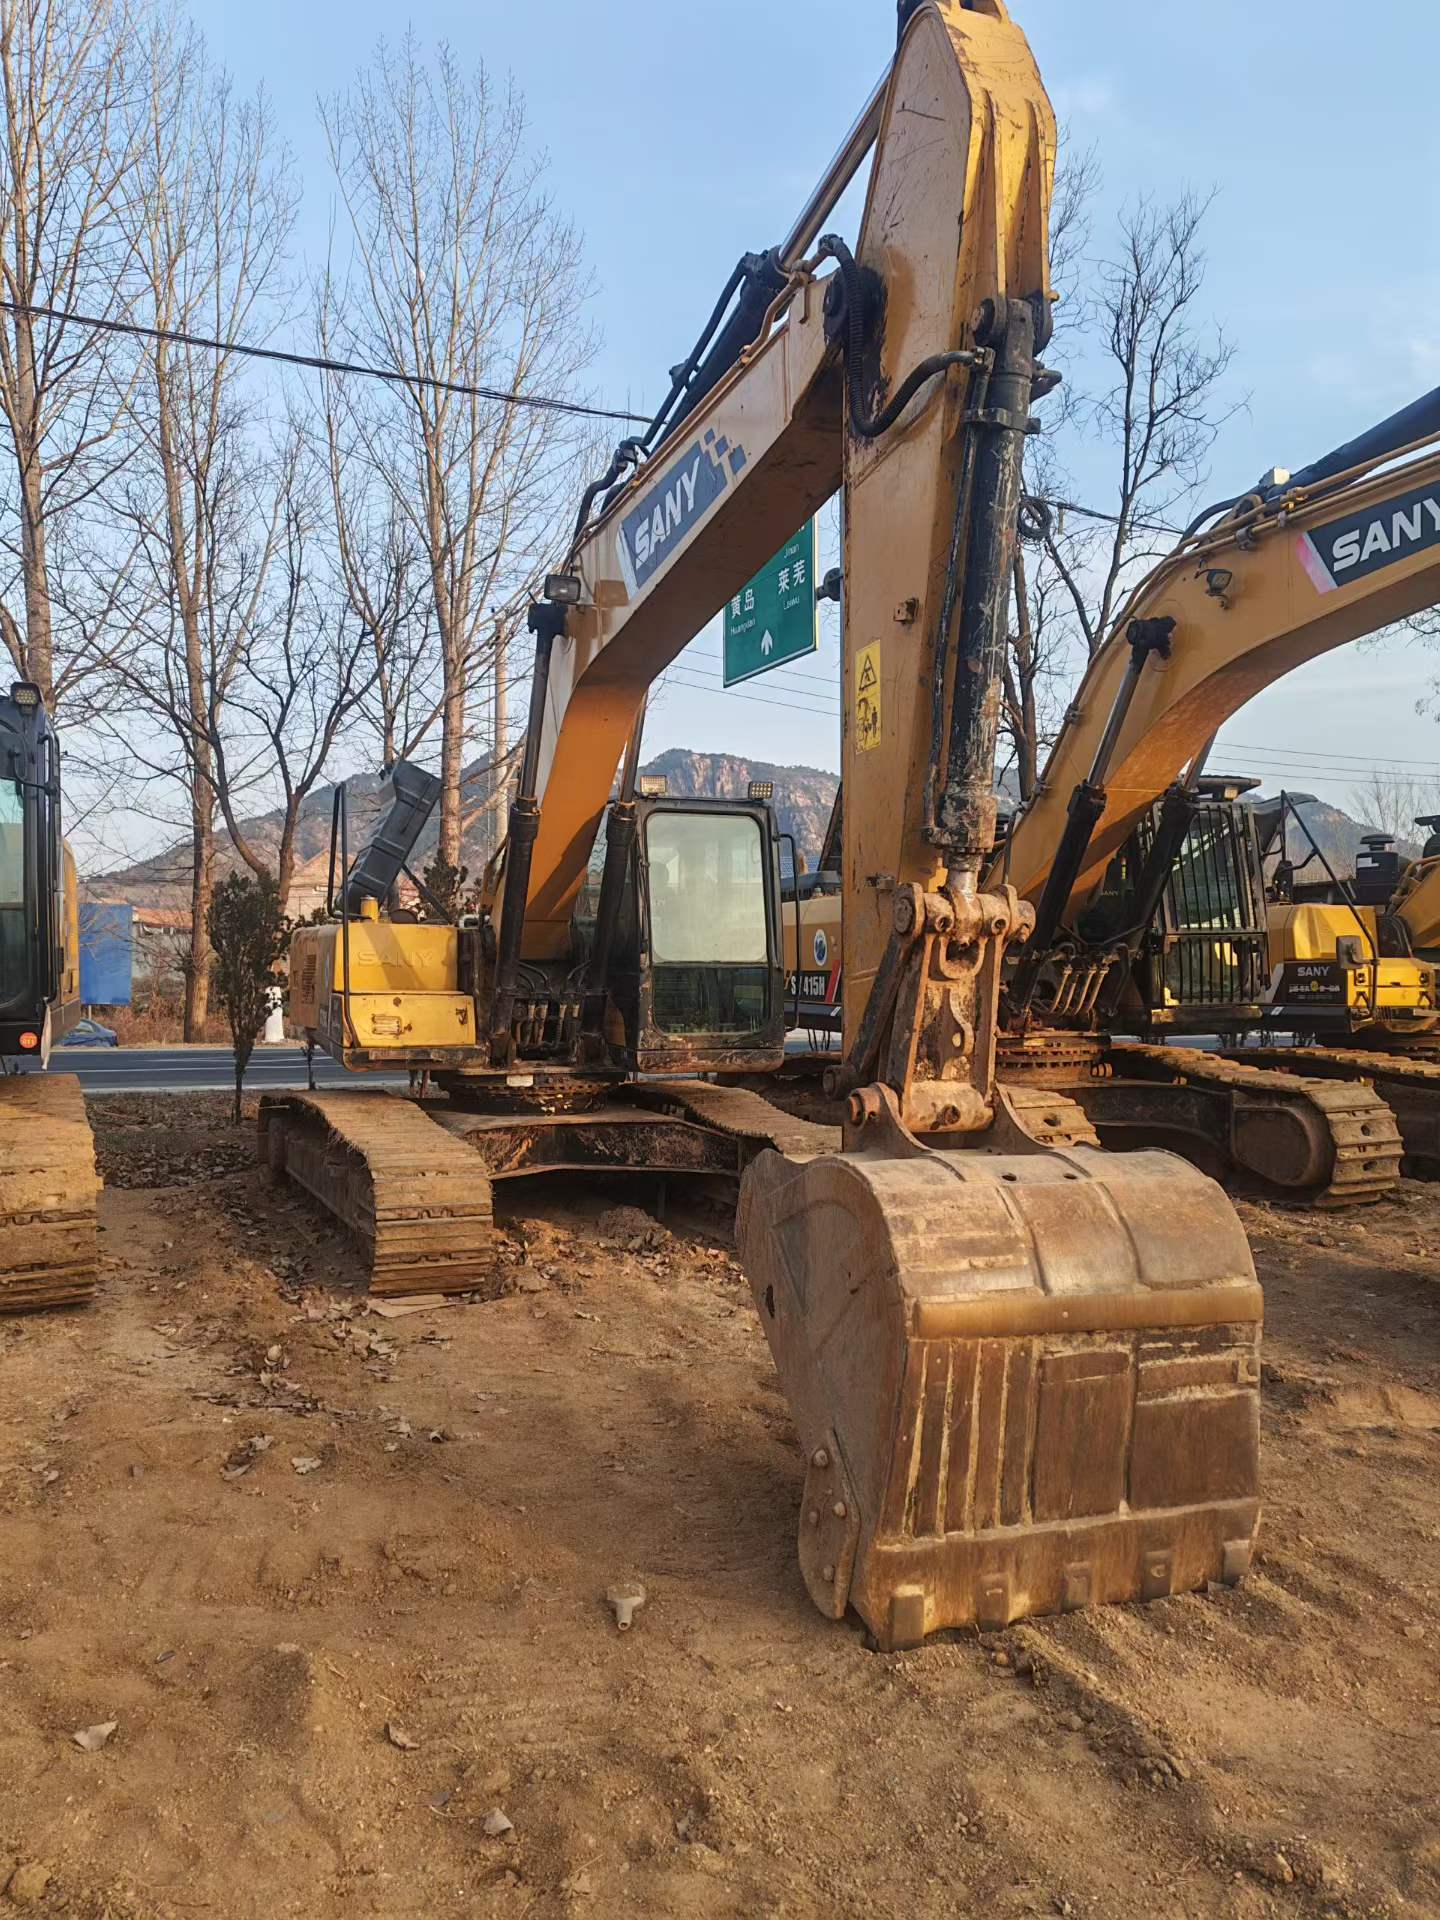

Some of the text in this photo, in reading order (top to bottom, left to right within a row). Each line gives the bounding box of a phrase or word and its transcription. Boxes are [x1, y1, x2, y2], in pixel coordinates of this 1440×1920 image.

[634, 456, 700, 570] SANY
[1332, 498, 1440, 572] SANY
[783, 543, 800, 559] Jinan
[777, 559, 806, 595] 莱芜
[730, 588, 755, 619] 黄岛
[357, 951, 434, 968] SANY
[1297, 966, 1330, 977] SANY
